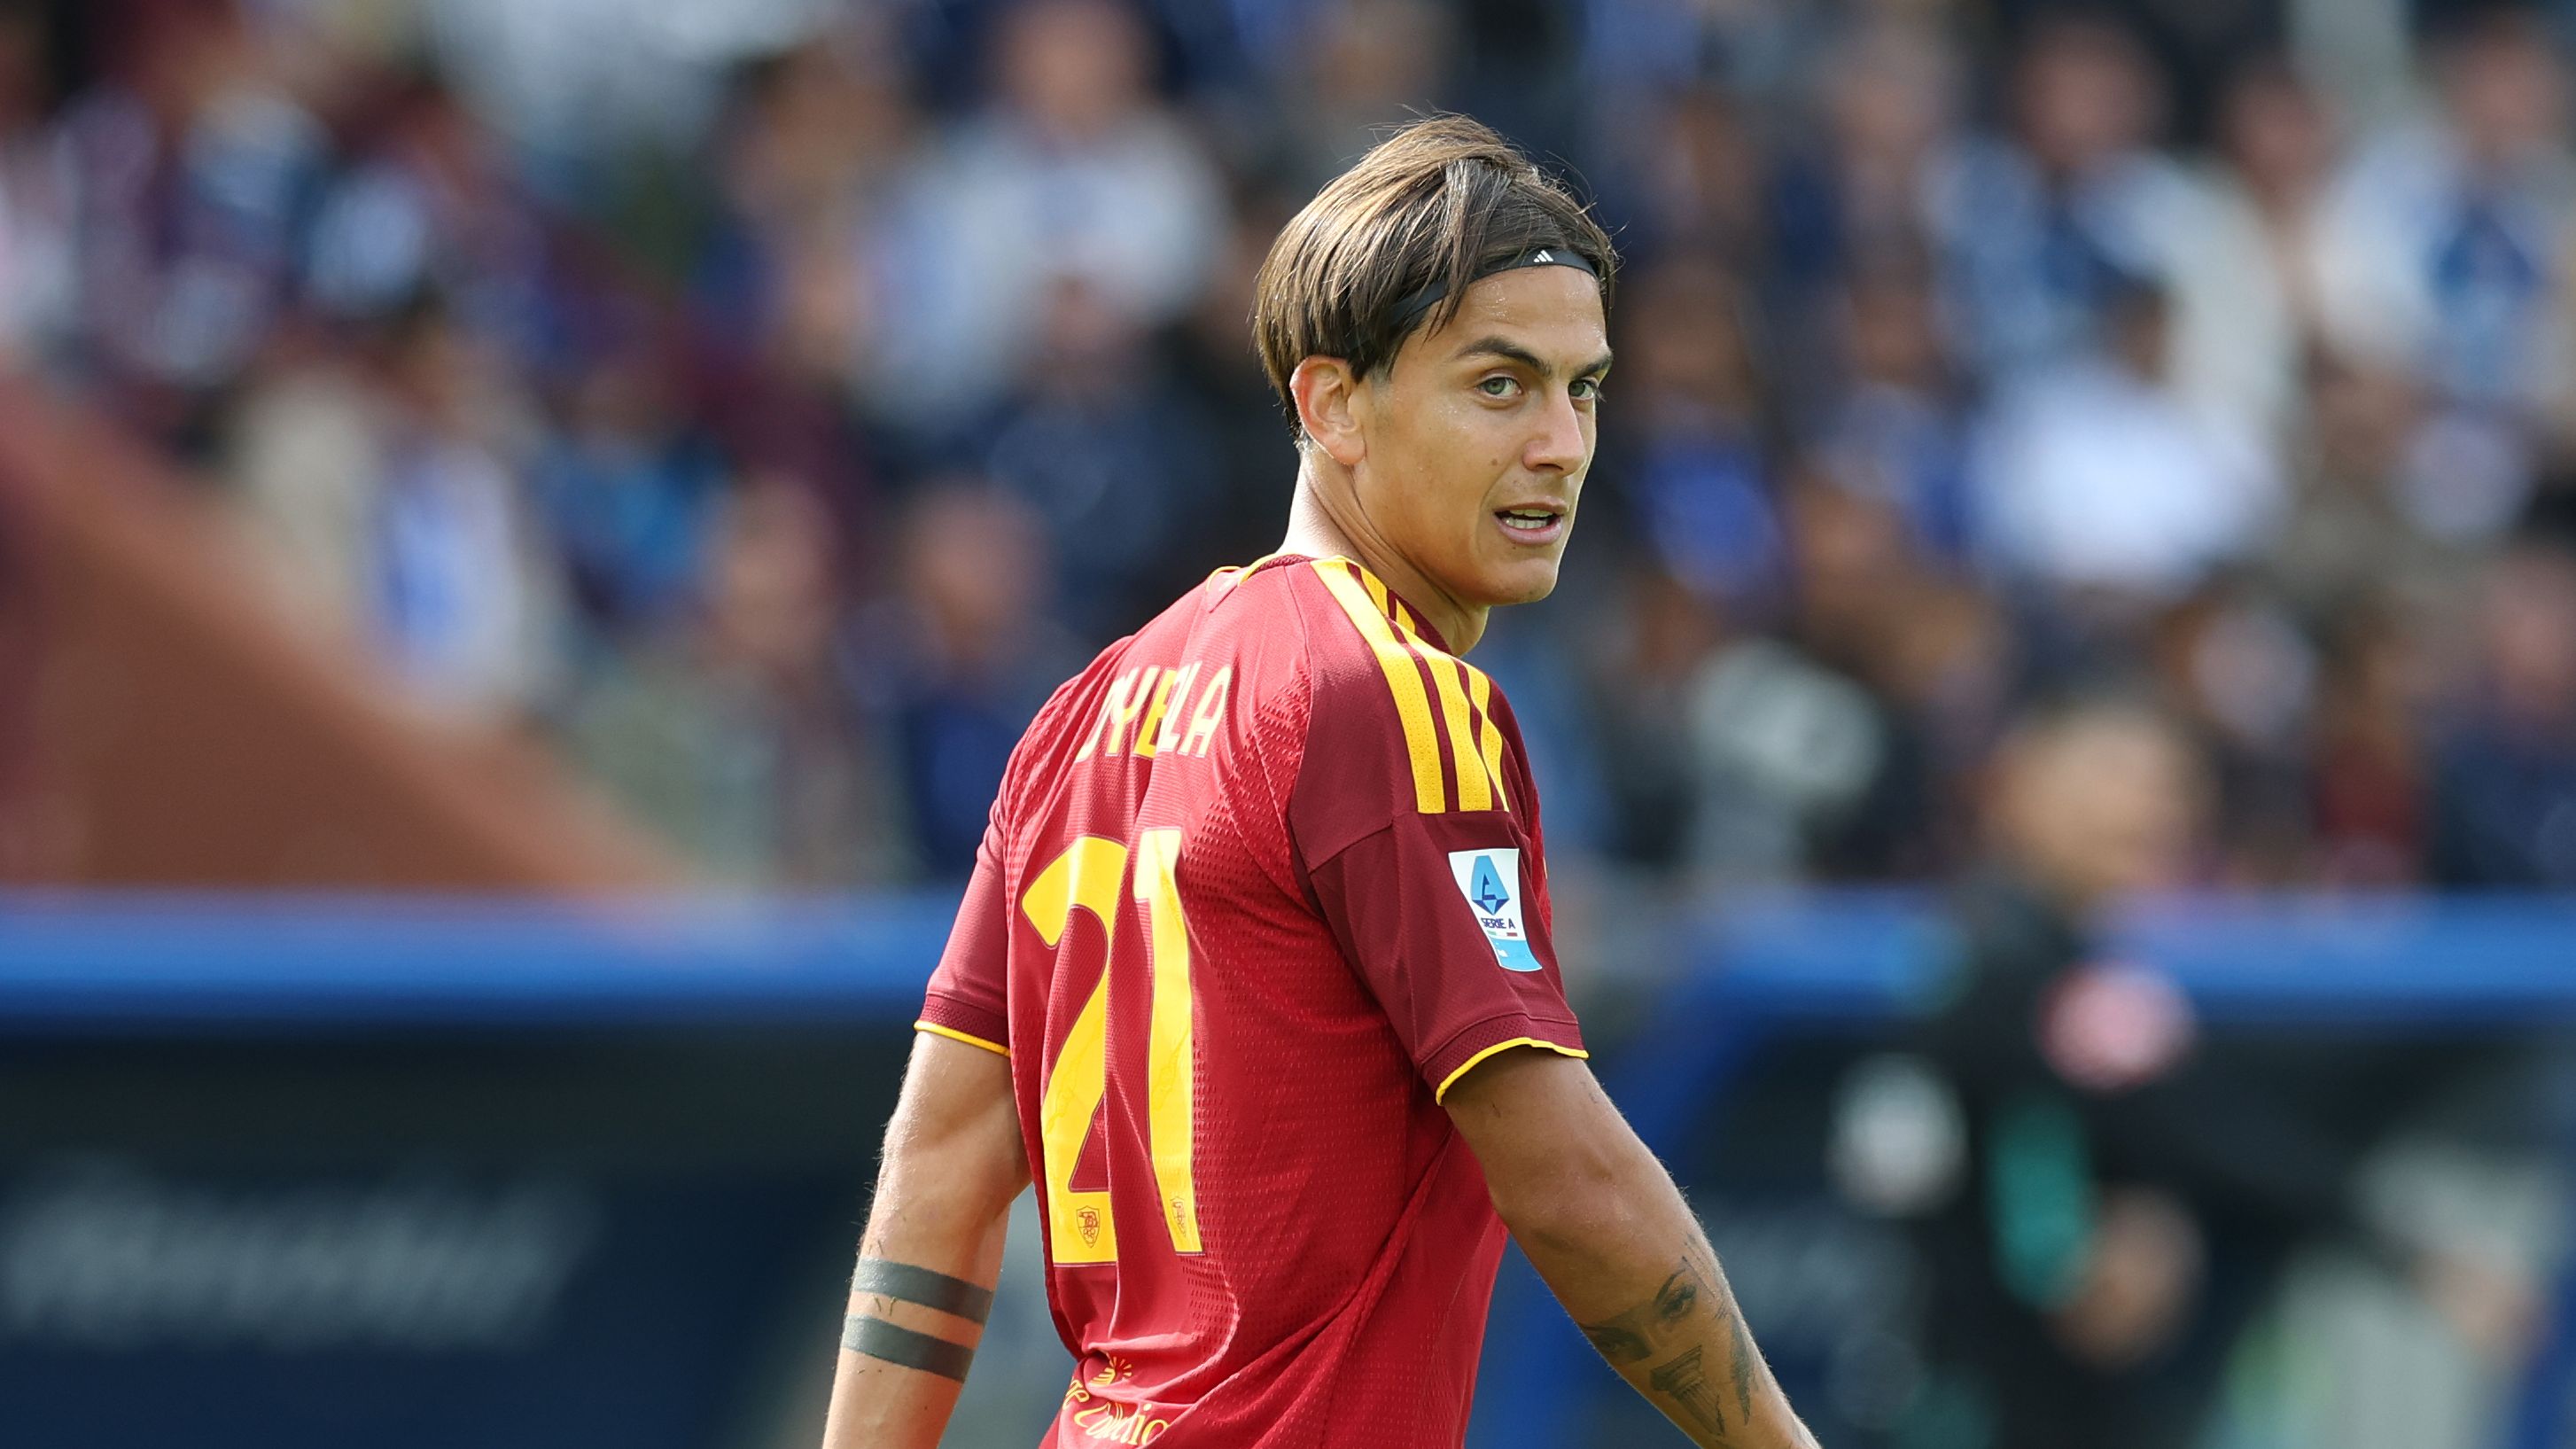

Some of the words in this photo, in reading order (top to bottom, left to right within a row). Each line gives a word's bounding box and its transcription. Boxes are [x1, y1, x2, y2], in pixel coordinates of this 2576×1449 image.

[1480, 916, 1507, 930] SERIE
[1508, 917, 1516, 930] A
[1021, 826, 1205, 1265] 21
